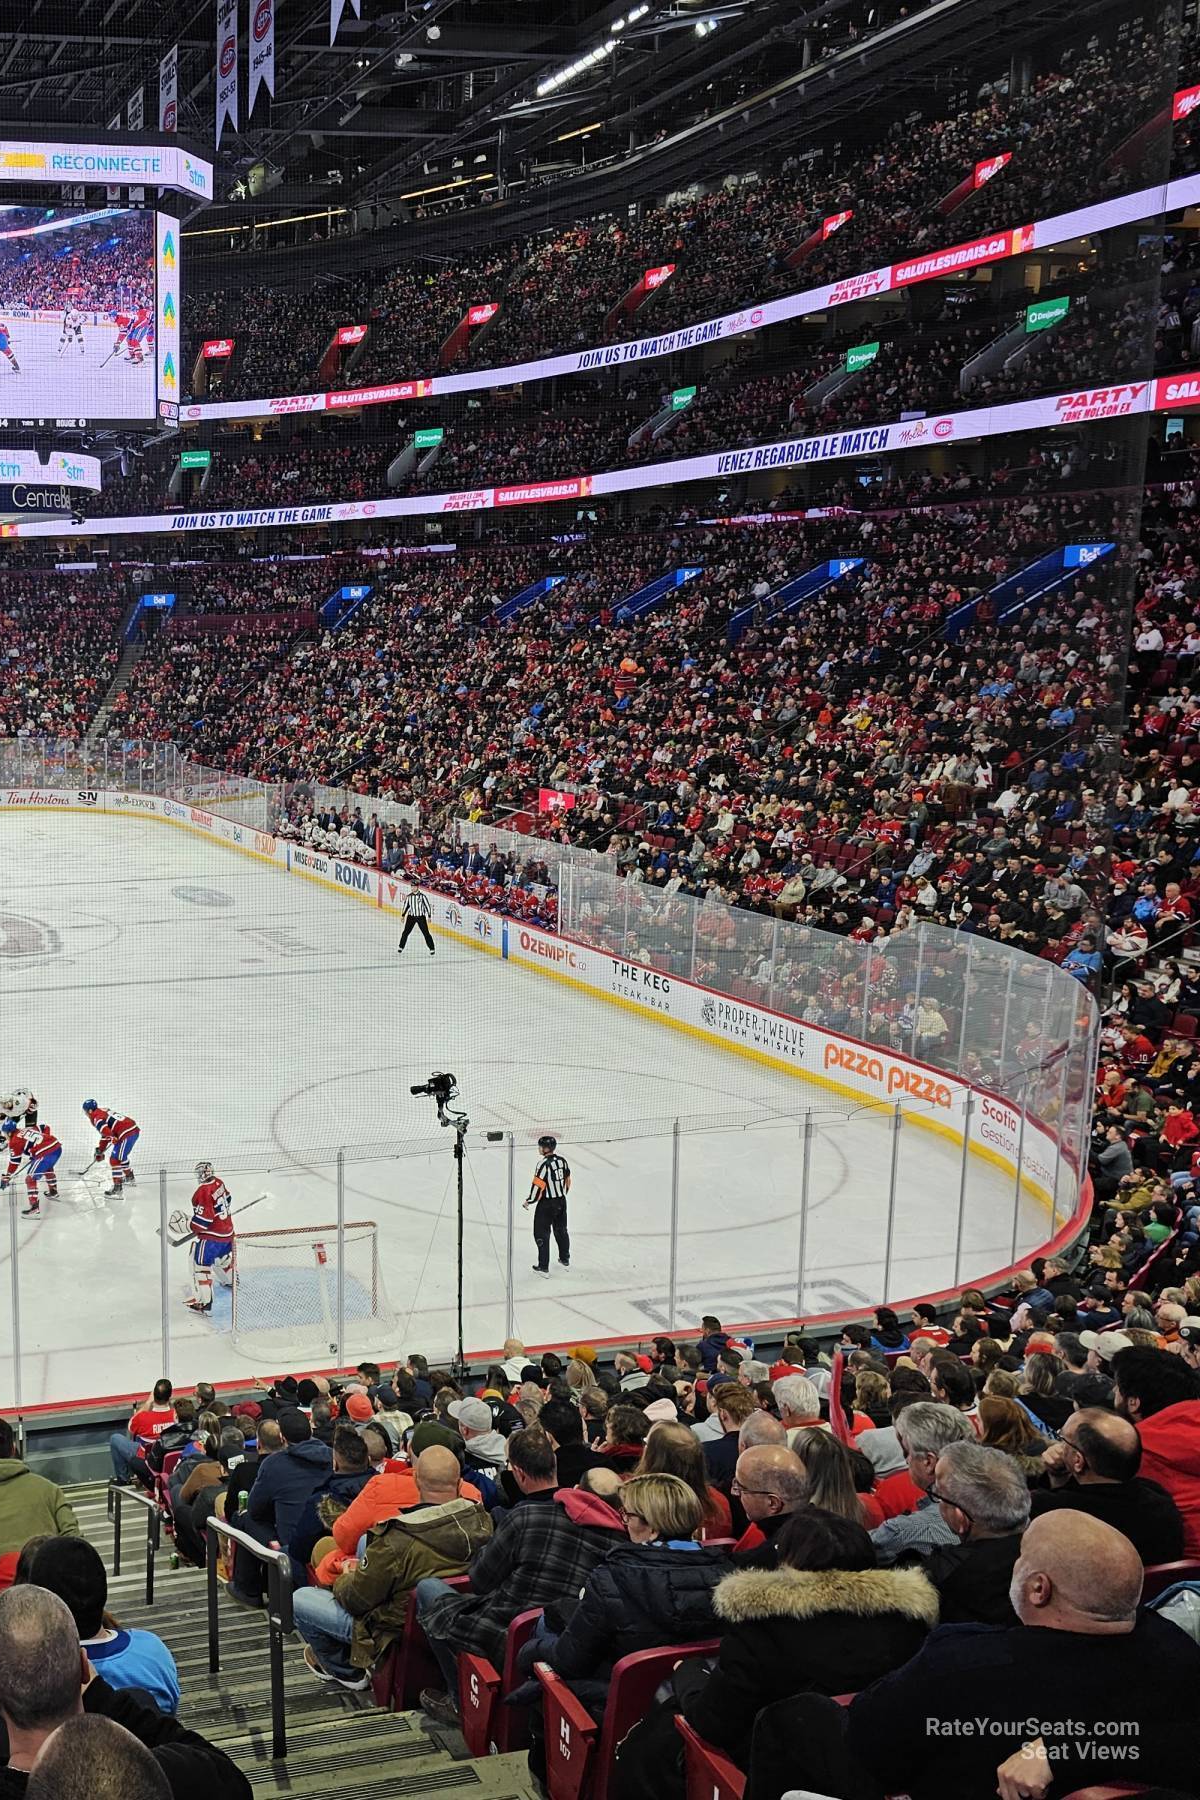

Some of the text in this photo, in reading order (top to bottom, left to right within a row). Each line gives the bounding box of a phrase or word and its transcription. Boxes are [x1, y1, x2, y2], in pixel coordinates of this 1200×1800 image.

[52, 154, 161, 173] RECONNECTE
[188, 168, 207, 189] stm
[895, 239, 1006, 281] SALUTLESVRAIS.CA
[828, 279, 885, 305] PARTY
[577, 322, 723, 370] JOIN US TO WATCH THE GAME
[270, 395, 321, 408] PARTY
[330, 385, 413, 405] SALUTLESVRAIS.CA
[1055, 383, 1149, 411] PARTY
[56, 418, 77, 427] ROUGE
[1061, 402, 1132, 423] ZONE MOLSON EX
[717, 427, 890, 474] VENEZ REGARDER LE MATCH
[66, 464, 85, 481] stm
[498, 483, 579, 503] SALUTLESVRAIS.CA
[443, 498, 490, 511] PARTY
[172, 506, 334, 530] JOIN US TO WATCH THE GAME
[6, 791, 69, 806] Tim Hortons
[78, 791, 98, 801] SN
[261, 838, 277, 856] SKIP
[335, 861, 372, 893] RONA
[612, 959, 670, 997] THE KEG
[611, 985, 671, 1012] STEAK BAR
[718, 1020, 806, 1060] IRISH WHISKEY
[823, 1042, 953, 1108] pizza pizza
[981, 1097, 1018, 1133] Scotia
[471, 1674, 479, 1695] G
[470, 1690, 480, 1709] 107
[560, 1716, 570, 1745] H
[559, 1739, 571, 1761] 107
